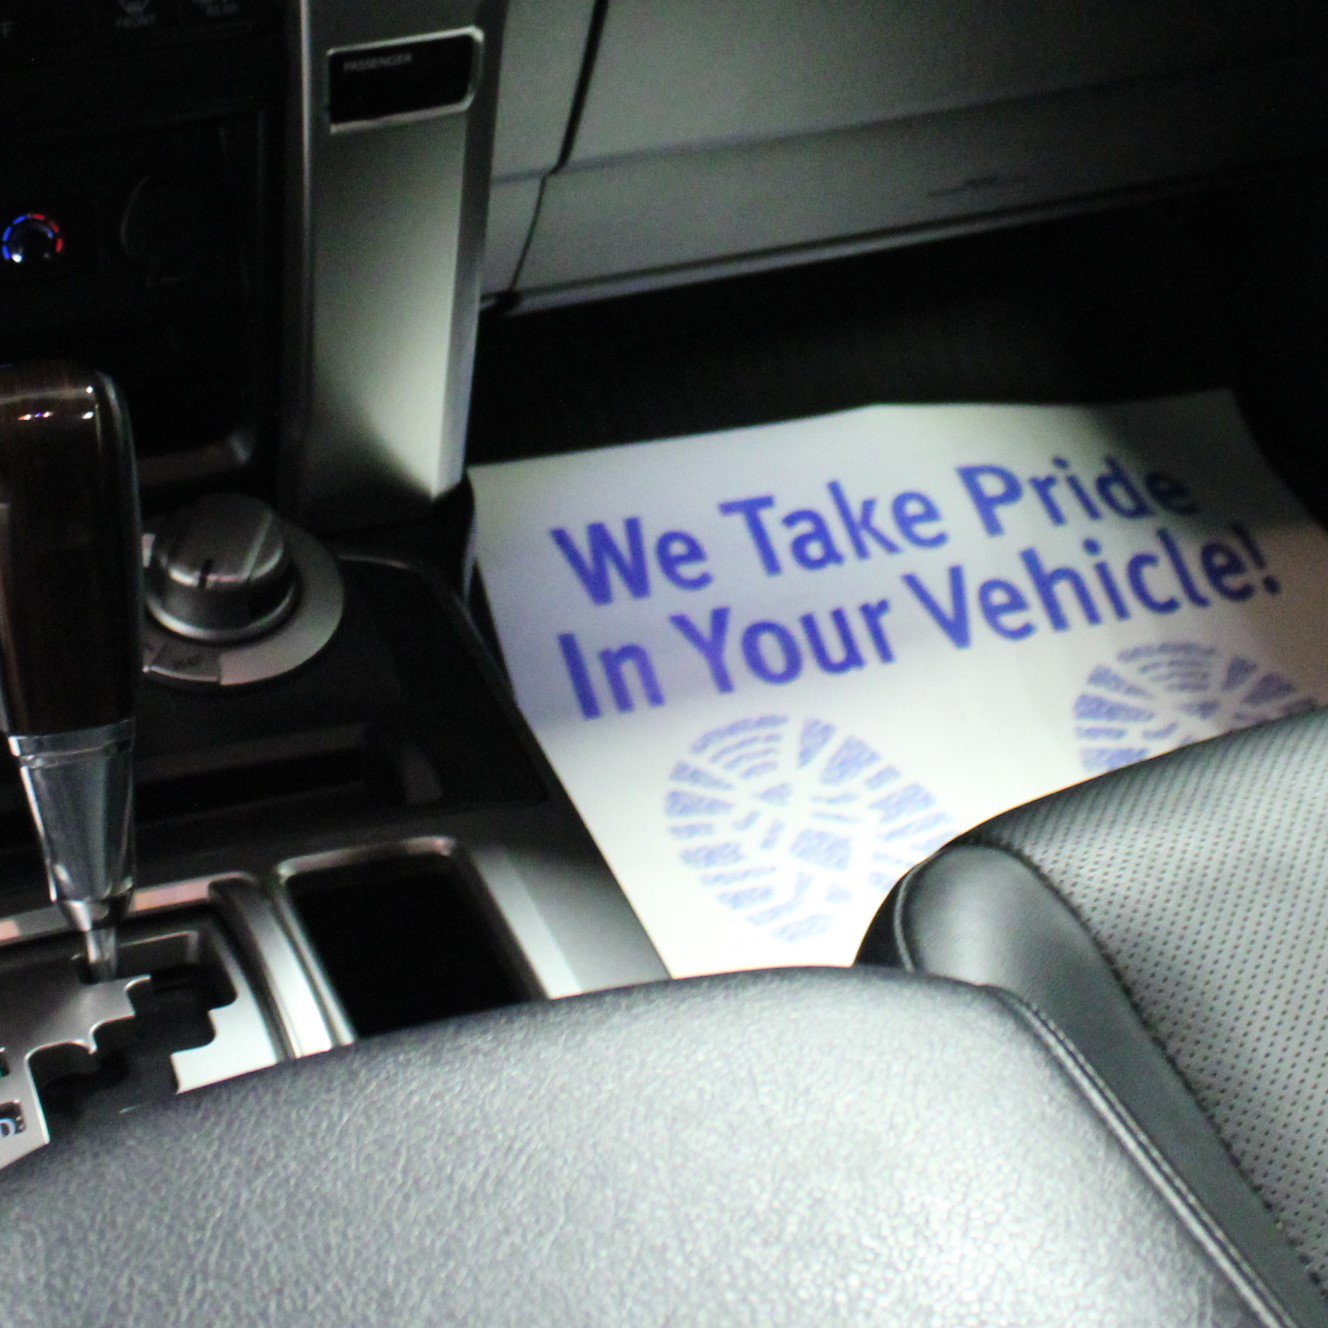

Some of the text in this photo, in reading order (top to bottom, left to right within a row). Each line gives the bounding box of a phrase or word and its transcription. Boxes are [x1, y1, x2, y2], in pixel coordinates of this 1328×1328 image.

[548, 453, 1204, 608] We Take Pride
[555, 522, 1283, 723] In Your Vehicle!
